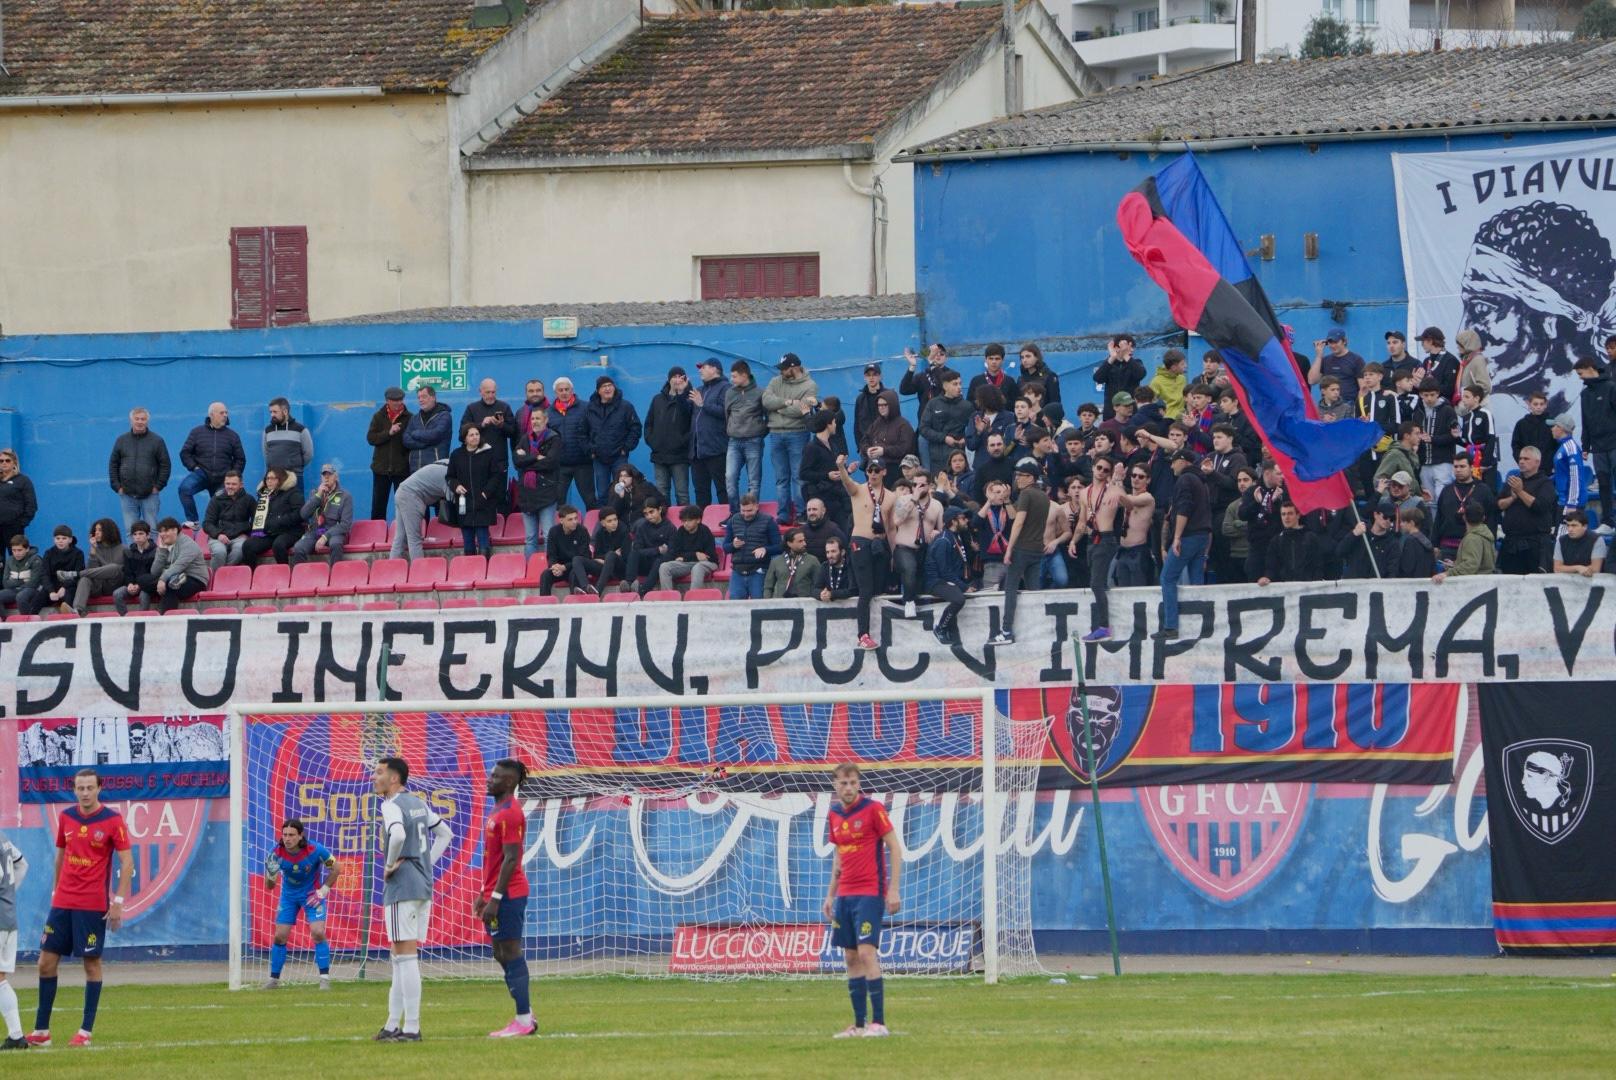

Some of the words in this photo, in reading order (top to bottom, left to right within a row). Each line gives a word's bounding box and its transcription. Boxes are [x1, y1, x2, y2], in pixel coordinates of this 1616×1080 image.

[1436, 180, 1457, 215] I
[403, 357, 447, 372] SORTIE
[455, 358, 462, 369] 1
[455, 377, 462, 387] 2
[1190, 684, 1411, 752] 1910
[1159, 783, 1287, 816] GFCA
[1214, 846, 1237, 857] 1910
